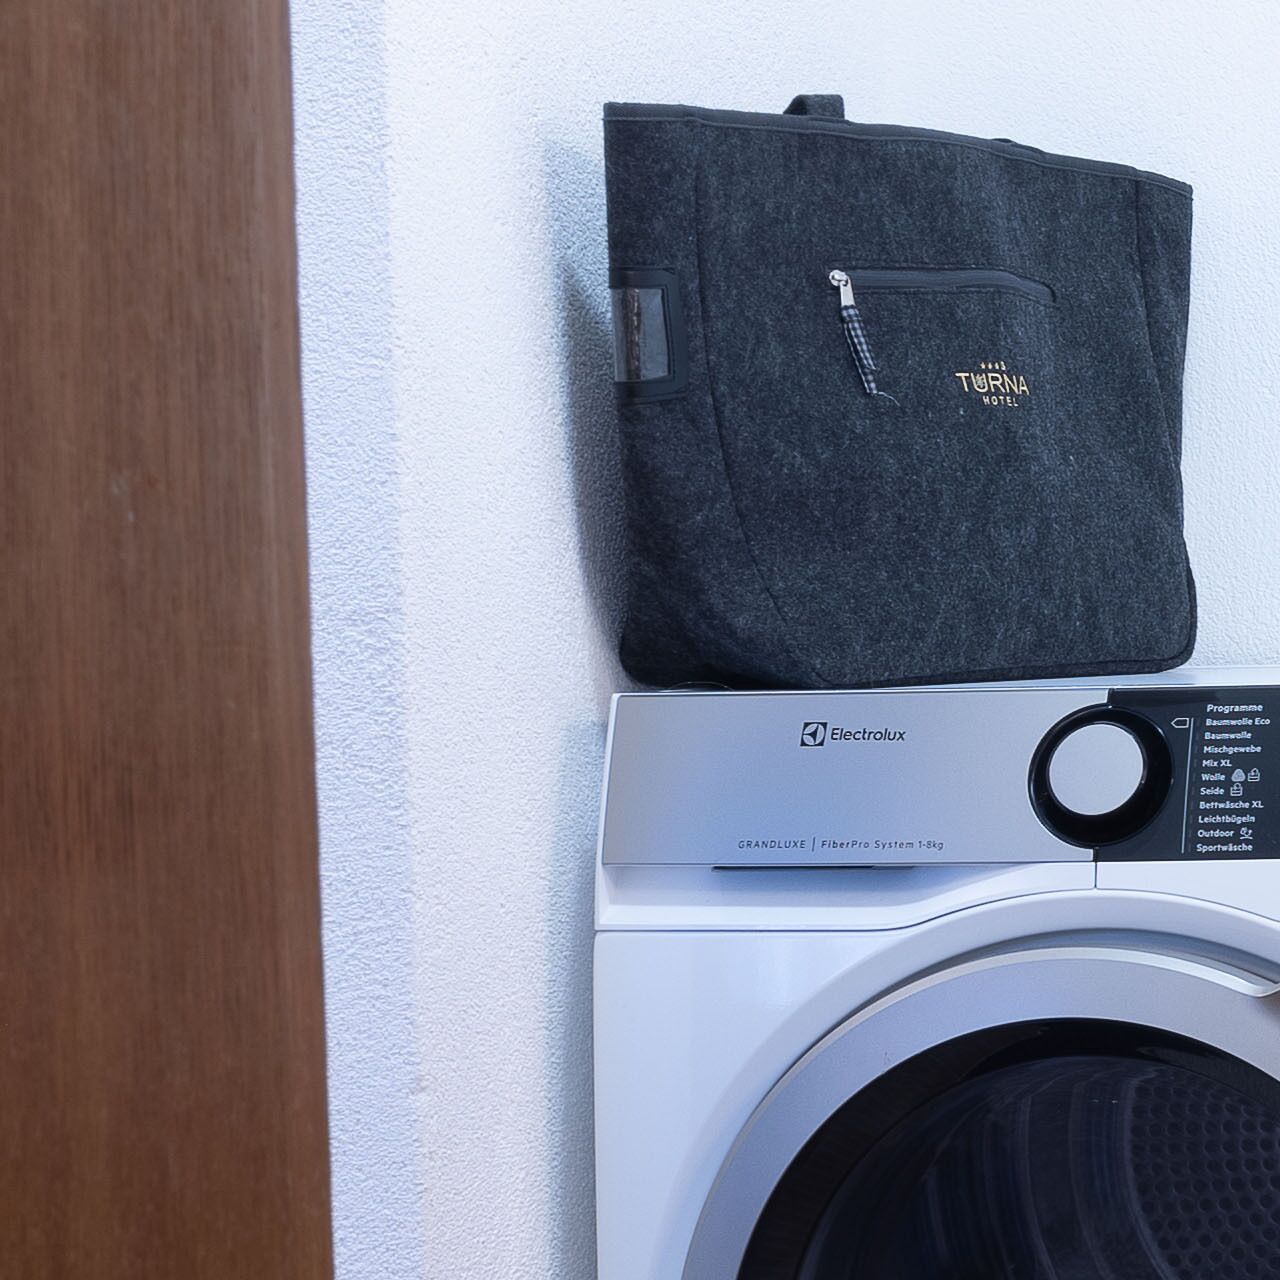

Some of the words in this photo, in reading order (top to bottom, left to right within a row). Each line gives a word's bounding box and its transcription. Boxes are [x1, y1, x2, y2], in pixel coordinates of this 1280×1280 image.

[955, 372, 1030, 395] TURNA
[982, 395, 1019, 407] HOTEL
[1206, 704, 1264, 714] Programme
[1205, 718, 1253, 726] Baumwolle
[1254, 717, 1271, 725] Eco
[831, 728, 906, 741] Electrolux
[1204, 731, 1252, 740] Baumwolle
[1203, 745, 1262, 755] Mischgewebe
[1202, 759, 1219, 767] Mix
[1220, 759, 1233, 767] XL
[1201, 773, 1226, 781] Wolle
[1200, 787, 1225, 795] Seide
[1251, 800, 1264, 808] XL
[1198, 814, 1256, 824] Leichtbügeln
[1197, 829, 1235, 838] Outdoor
[738, 840, 806, 849] GRANDLUXE
[821, 840, 869, 849] FiberPro
[874, 840, 914, 850] System
[918, 840, 944, 851] 1-8kg
